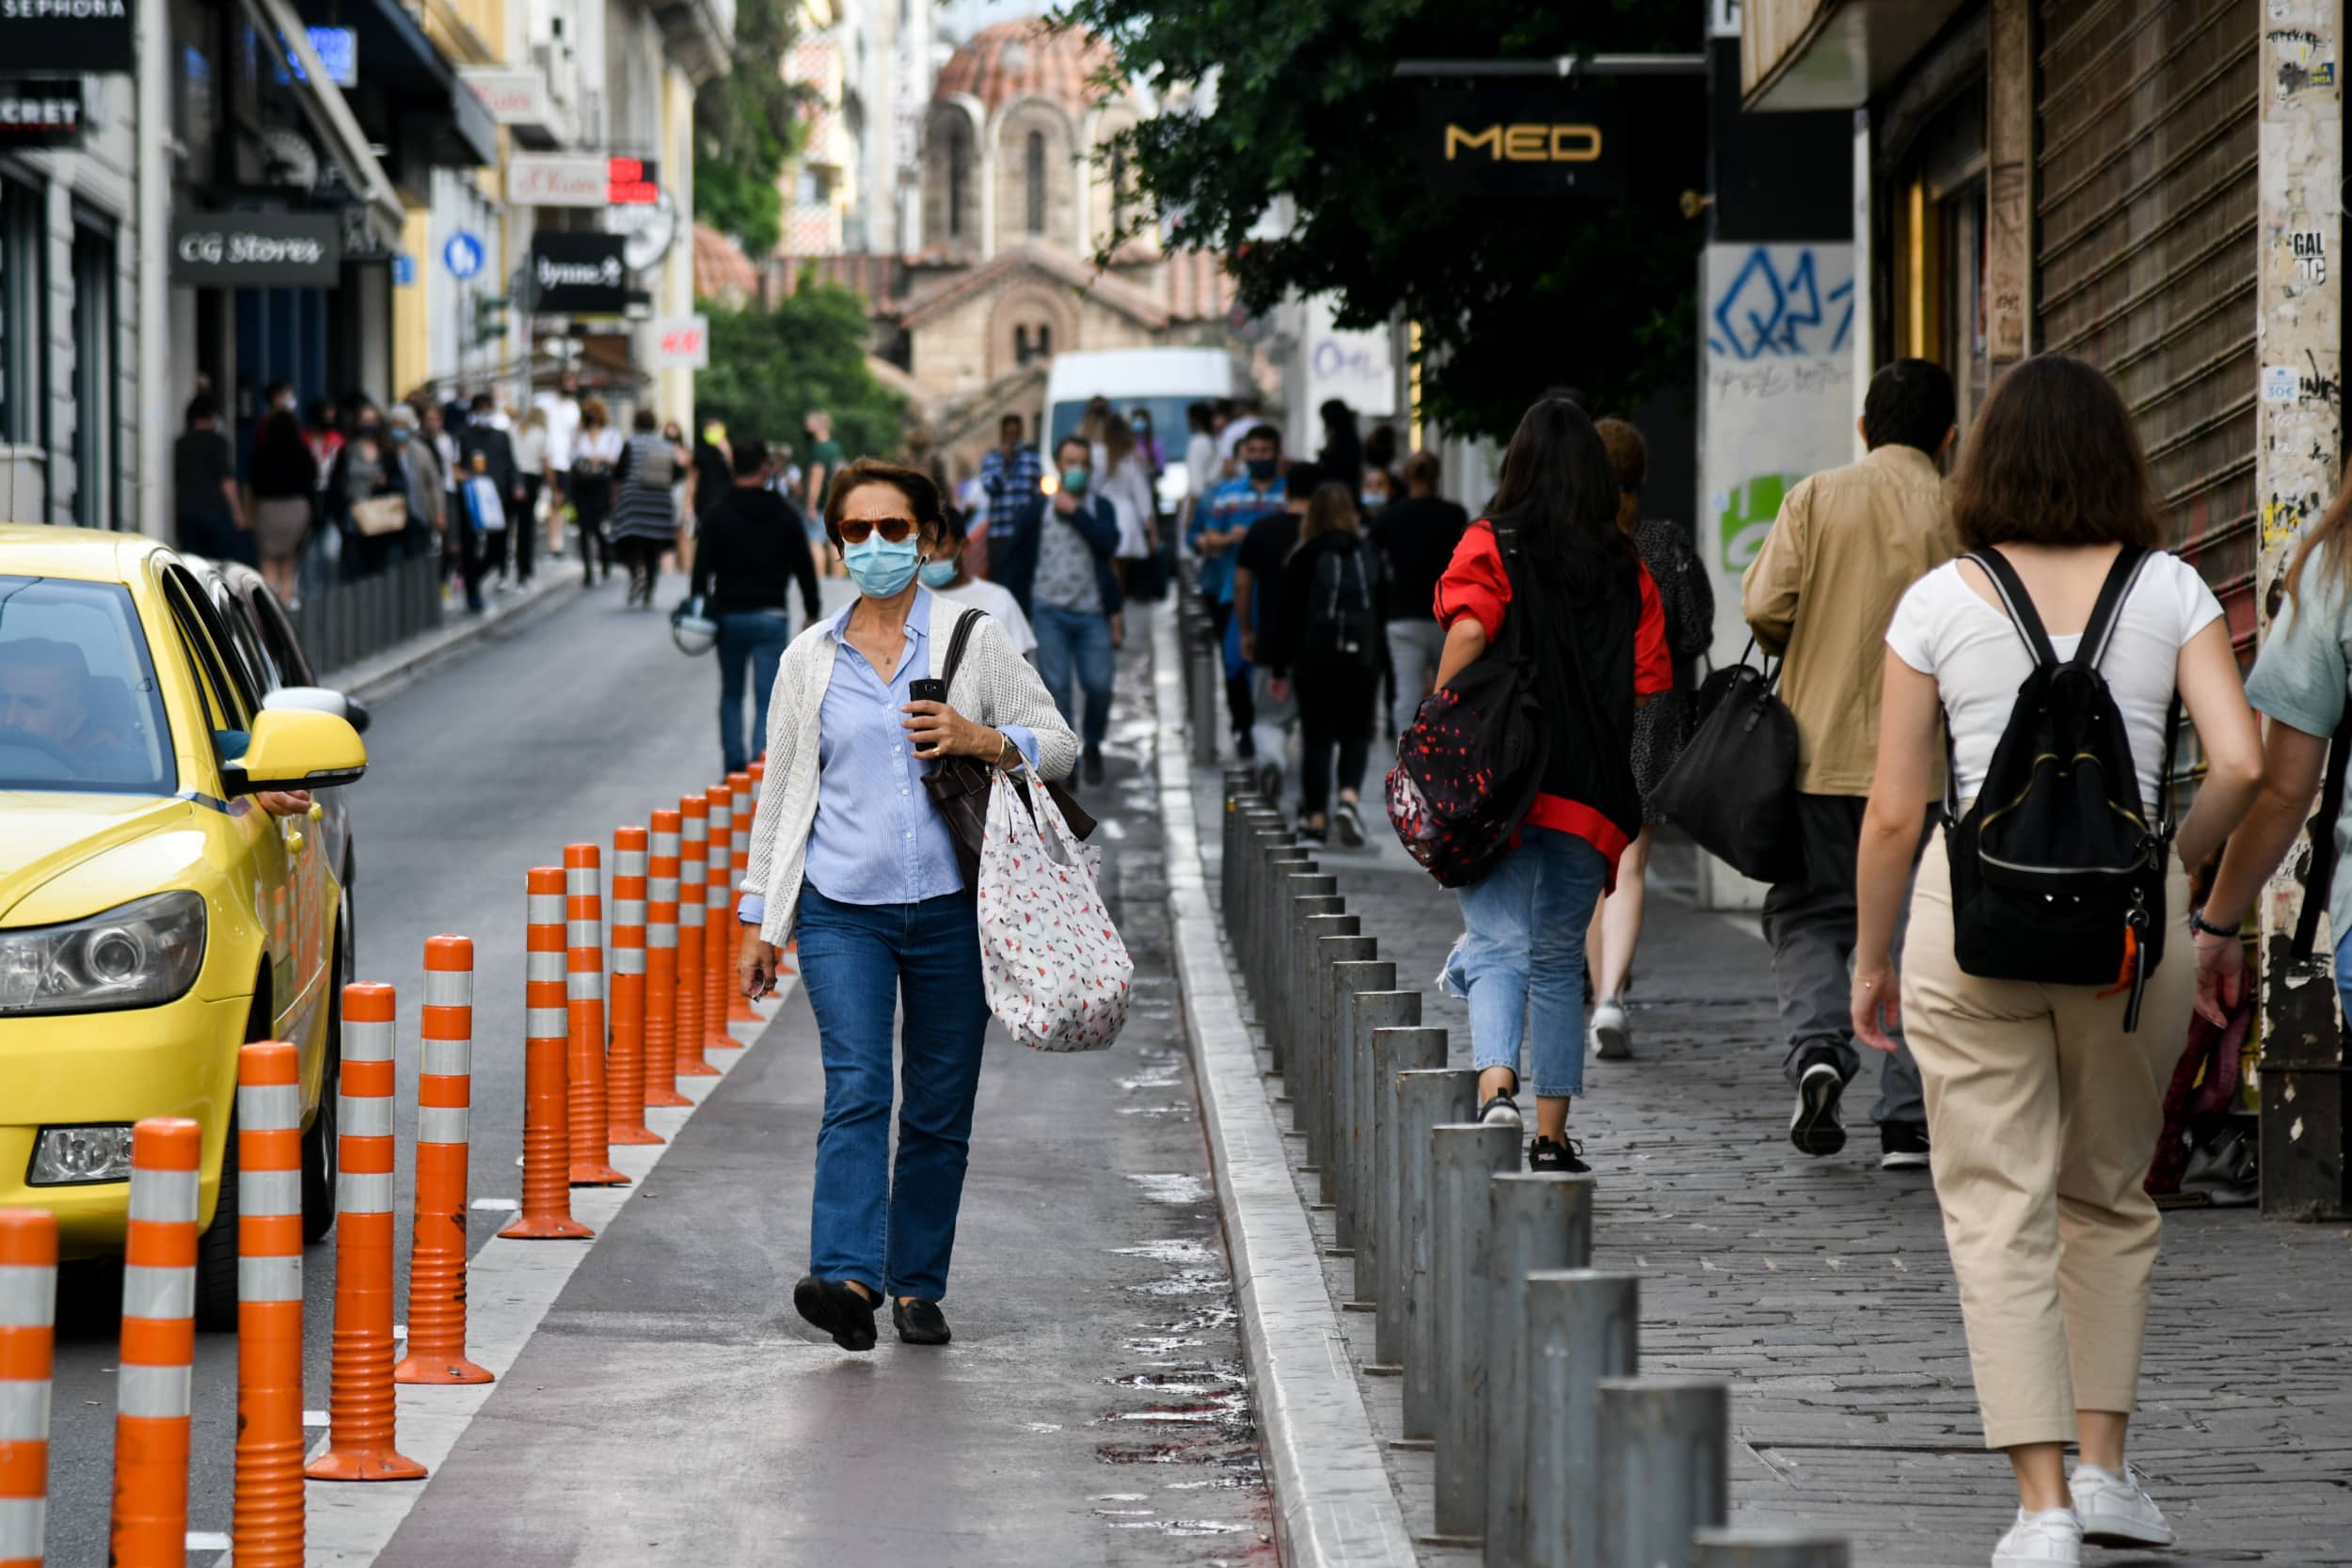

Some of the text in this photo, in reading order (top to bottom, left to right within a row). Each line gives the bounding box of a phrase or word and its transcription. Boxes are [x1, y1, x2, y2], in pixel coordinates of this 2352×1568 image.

[3, 0, 125, 17] SEPHORA
[1445, 123, 1602, 161] MED
[178, 231, 324, 264] CG Stores
